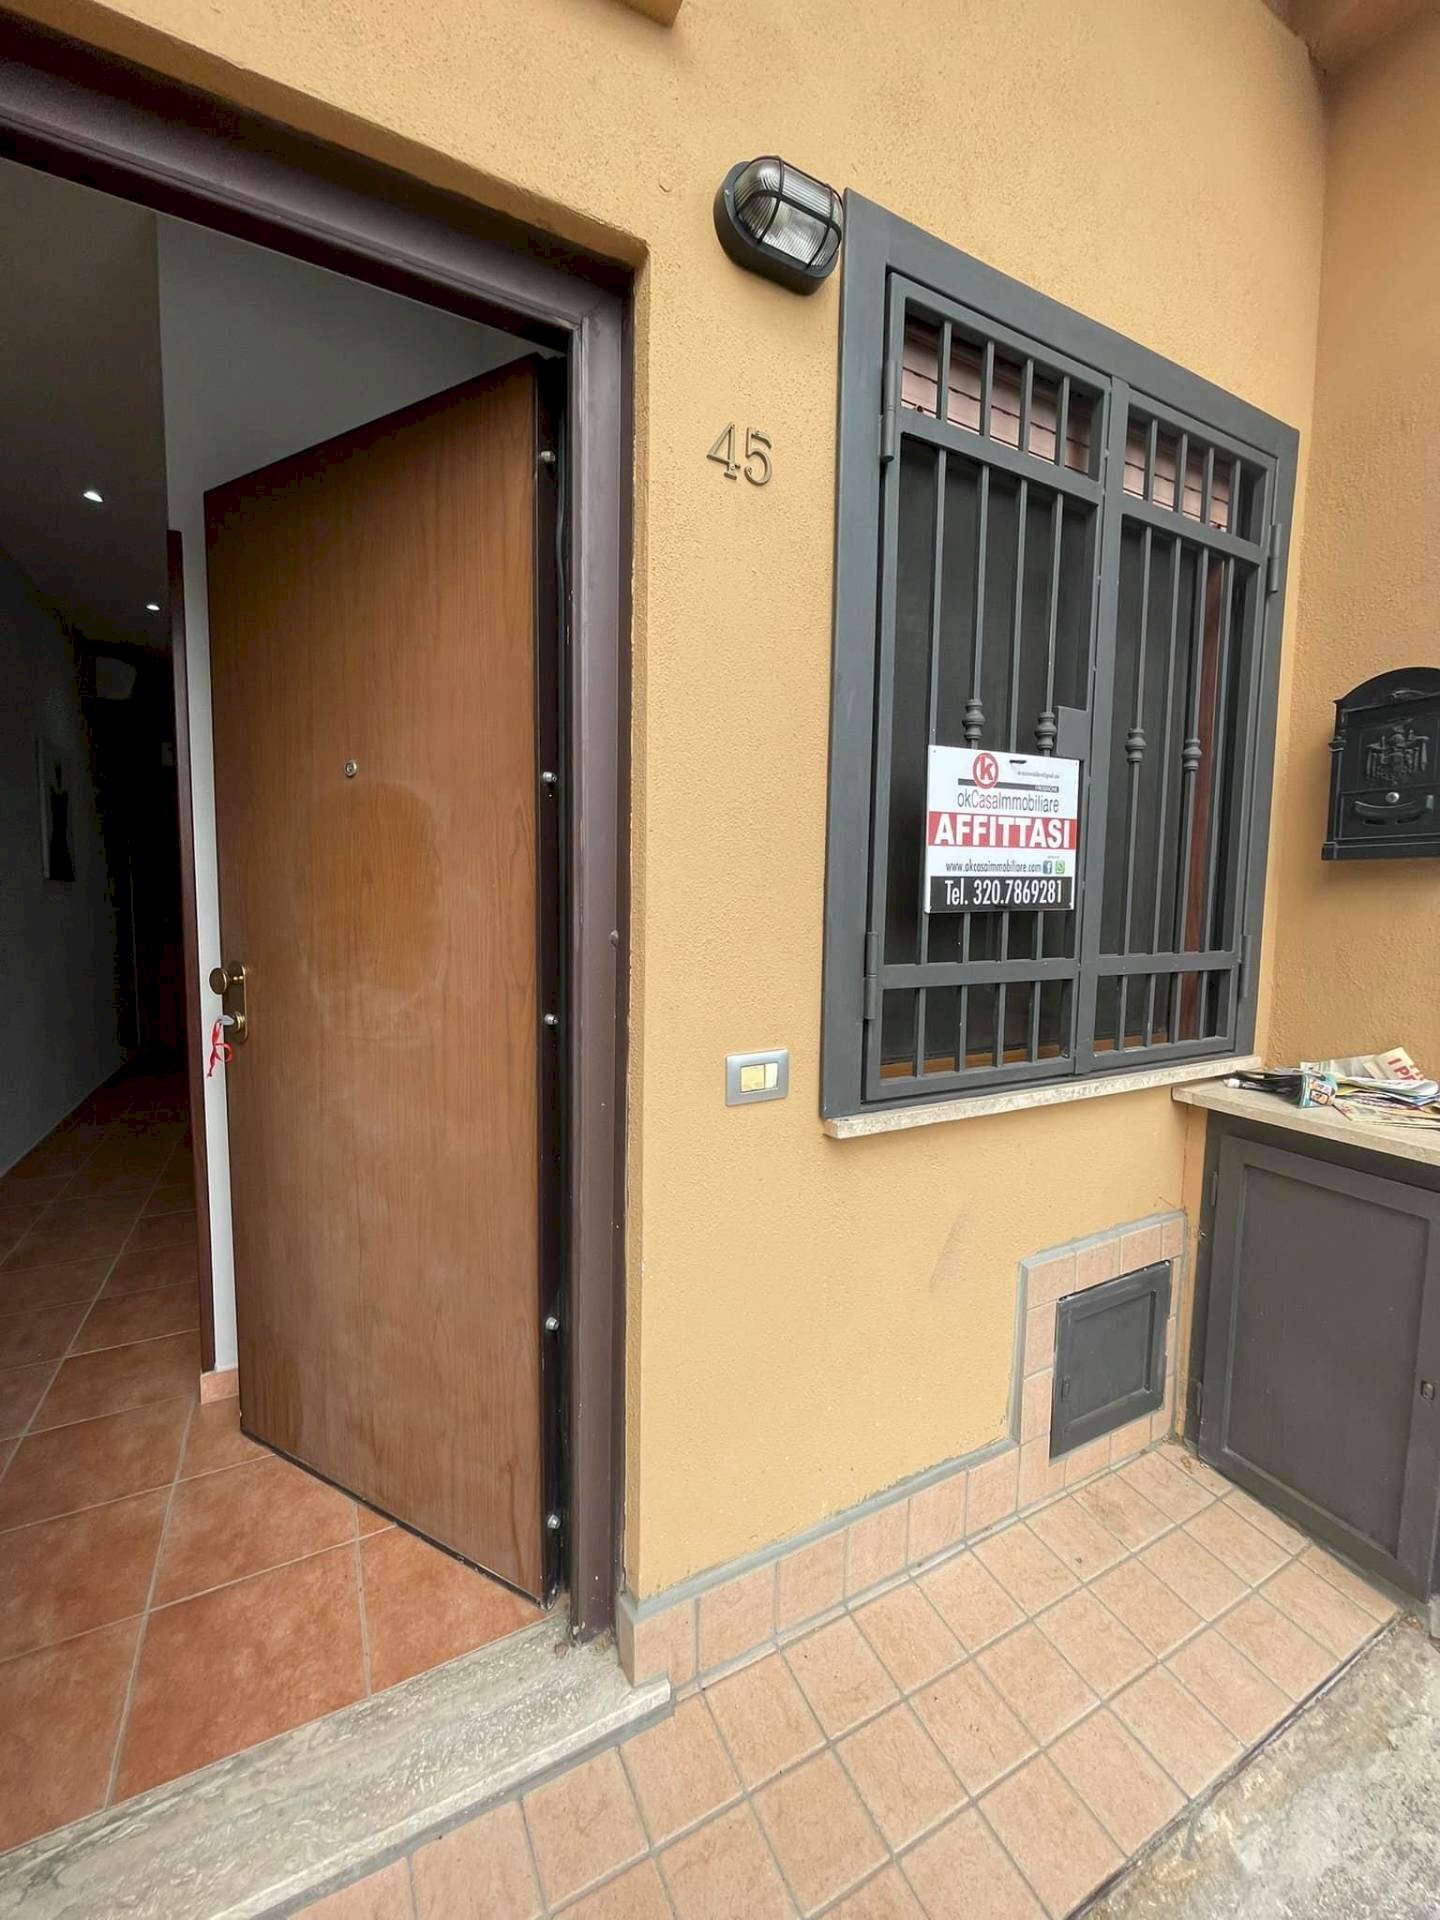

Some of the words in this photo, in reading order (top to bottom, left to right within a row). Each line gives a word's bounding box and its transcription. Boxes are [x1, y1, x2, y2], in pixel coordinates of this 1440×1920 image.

[706, 422, 772, 487] 45
[957, 790, 1060, 813] okCasaImmobiliare
[934, 814, 1070, 849] AFFITTASI
[946, 859, 1041, 874] www.okcasaimmobiliare.com
[945, 878, 968, 905] Tel.
[973, 879, 1062, 905] 320.7869281
